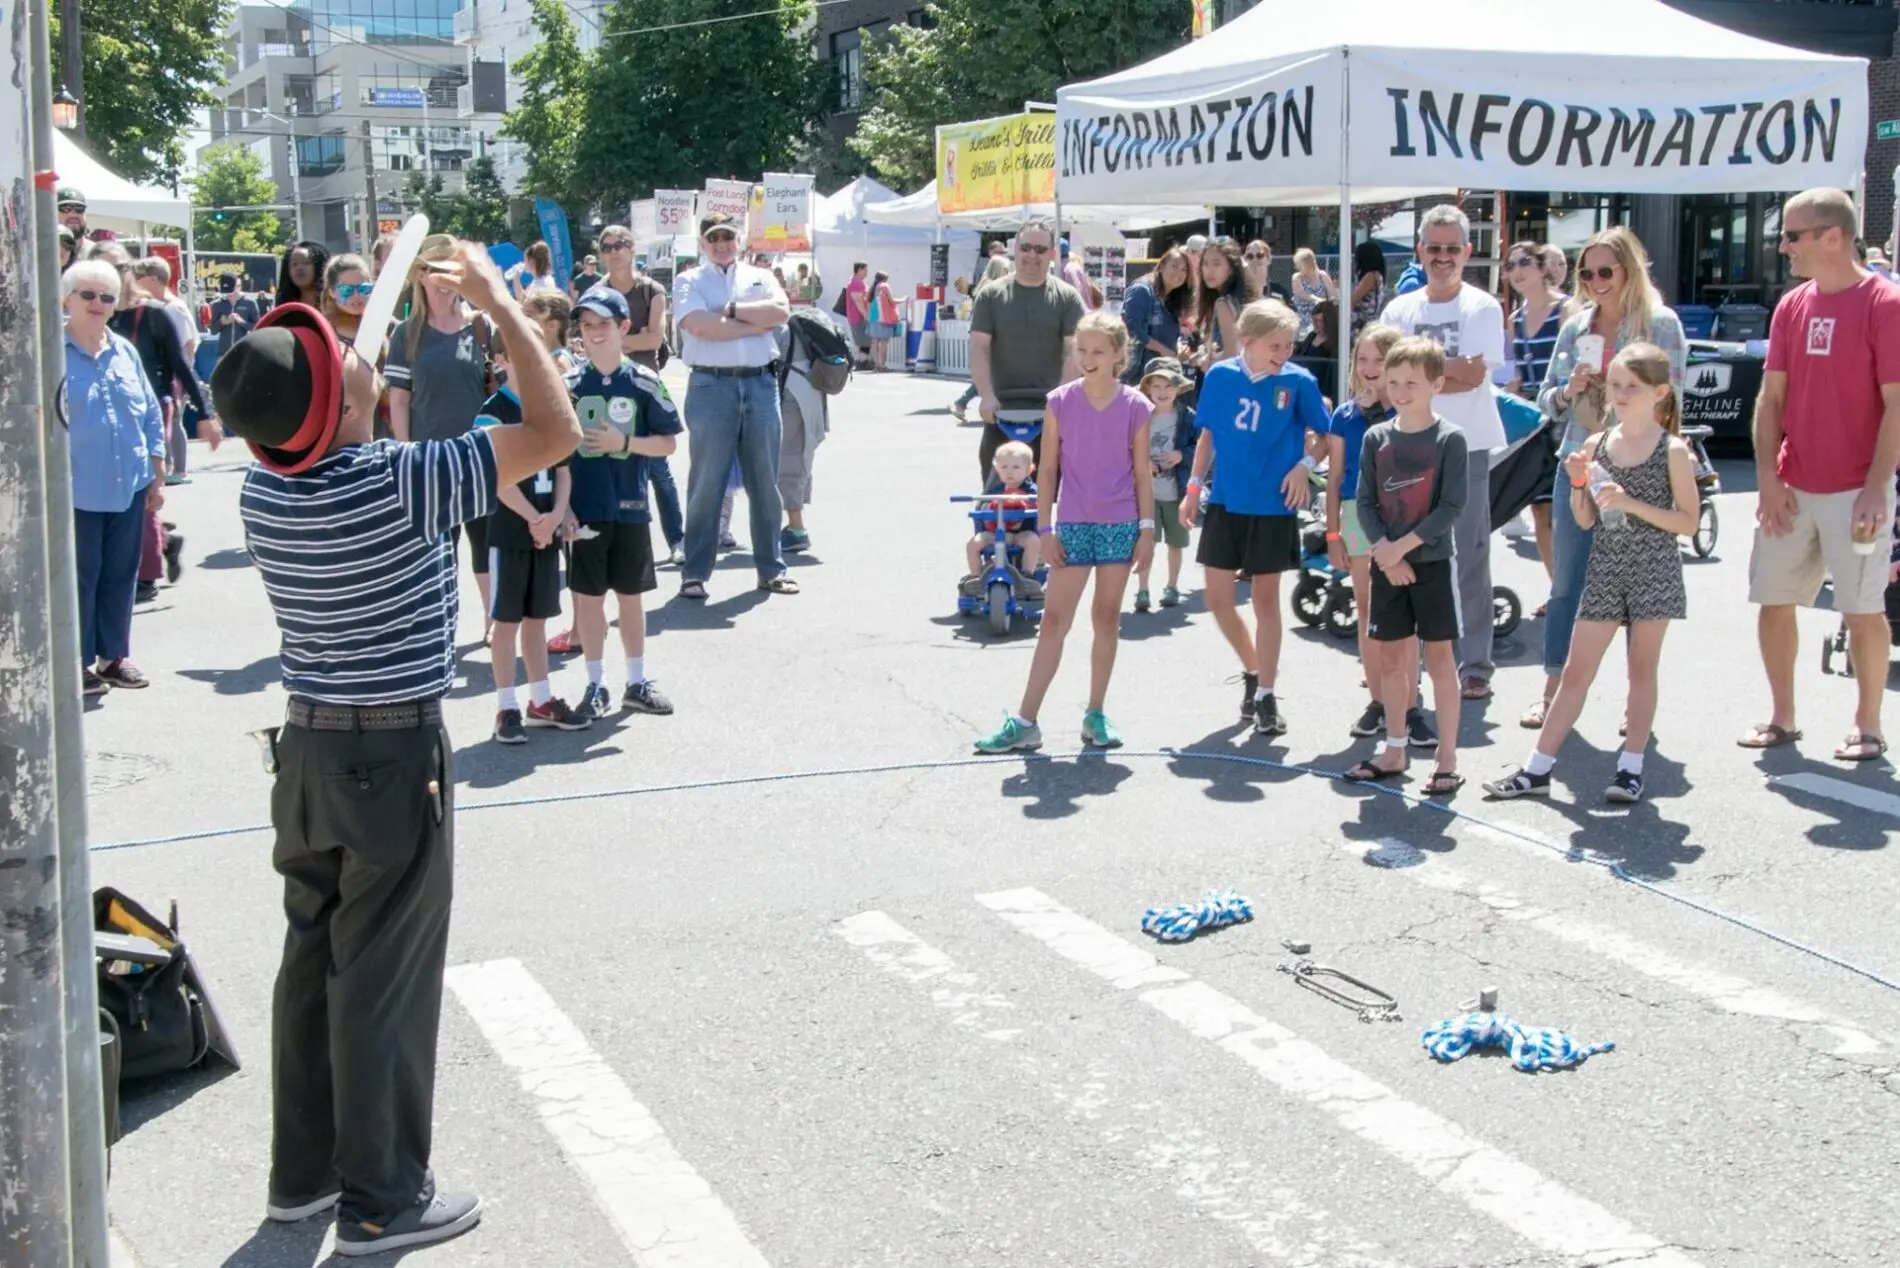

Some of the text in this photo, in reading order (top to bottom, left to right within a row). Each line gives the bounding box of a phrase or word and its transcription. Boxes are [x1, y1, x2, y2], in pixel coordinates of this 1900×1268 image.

[1062, 85, 1314, 178] INFORMATION
[1386, 87, 1841, 168] INFORMATION
[726, 189, 746, 200] Long
[766, 187, 806, 199] Elephant
[658, 195, 690, 205] Noodles
[706, 201, 746, 216] Corndog
[777, 203, 798, 213] Ears
[1681, 398, 1742, 411] GHLINE
[1235, 397, 1261, 433] 21
[1700, 411, 1740, 420] THERAPY
